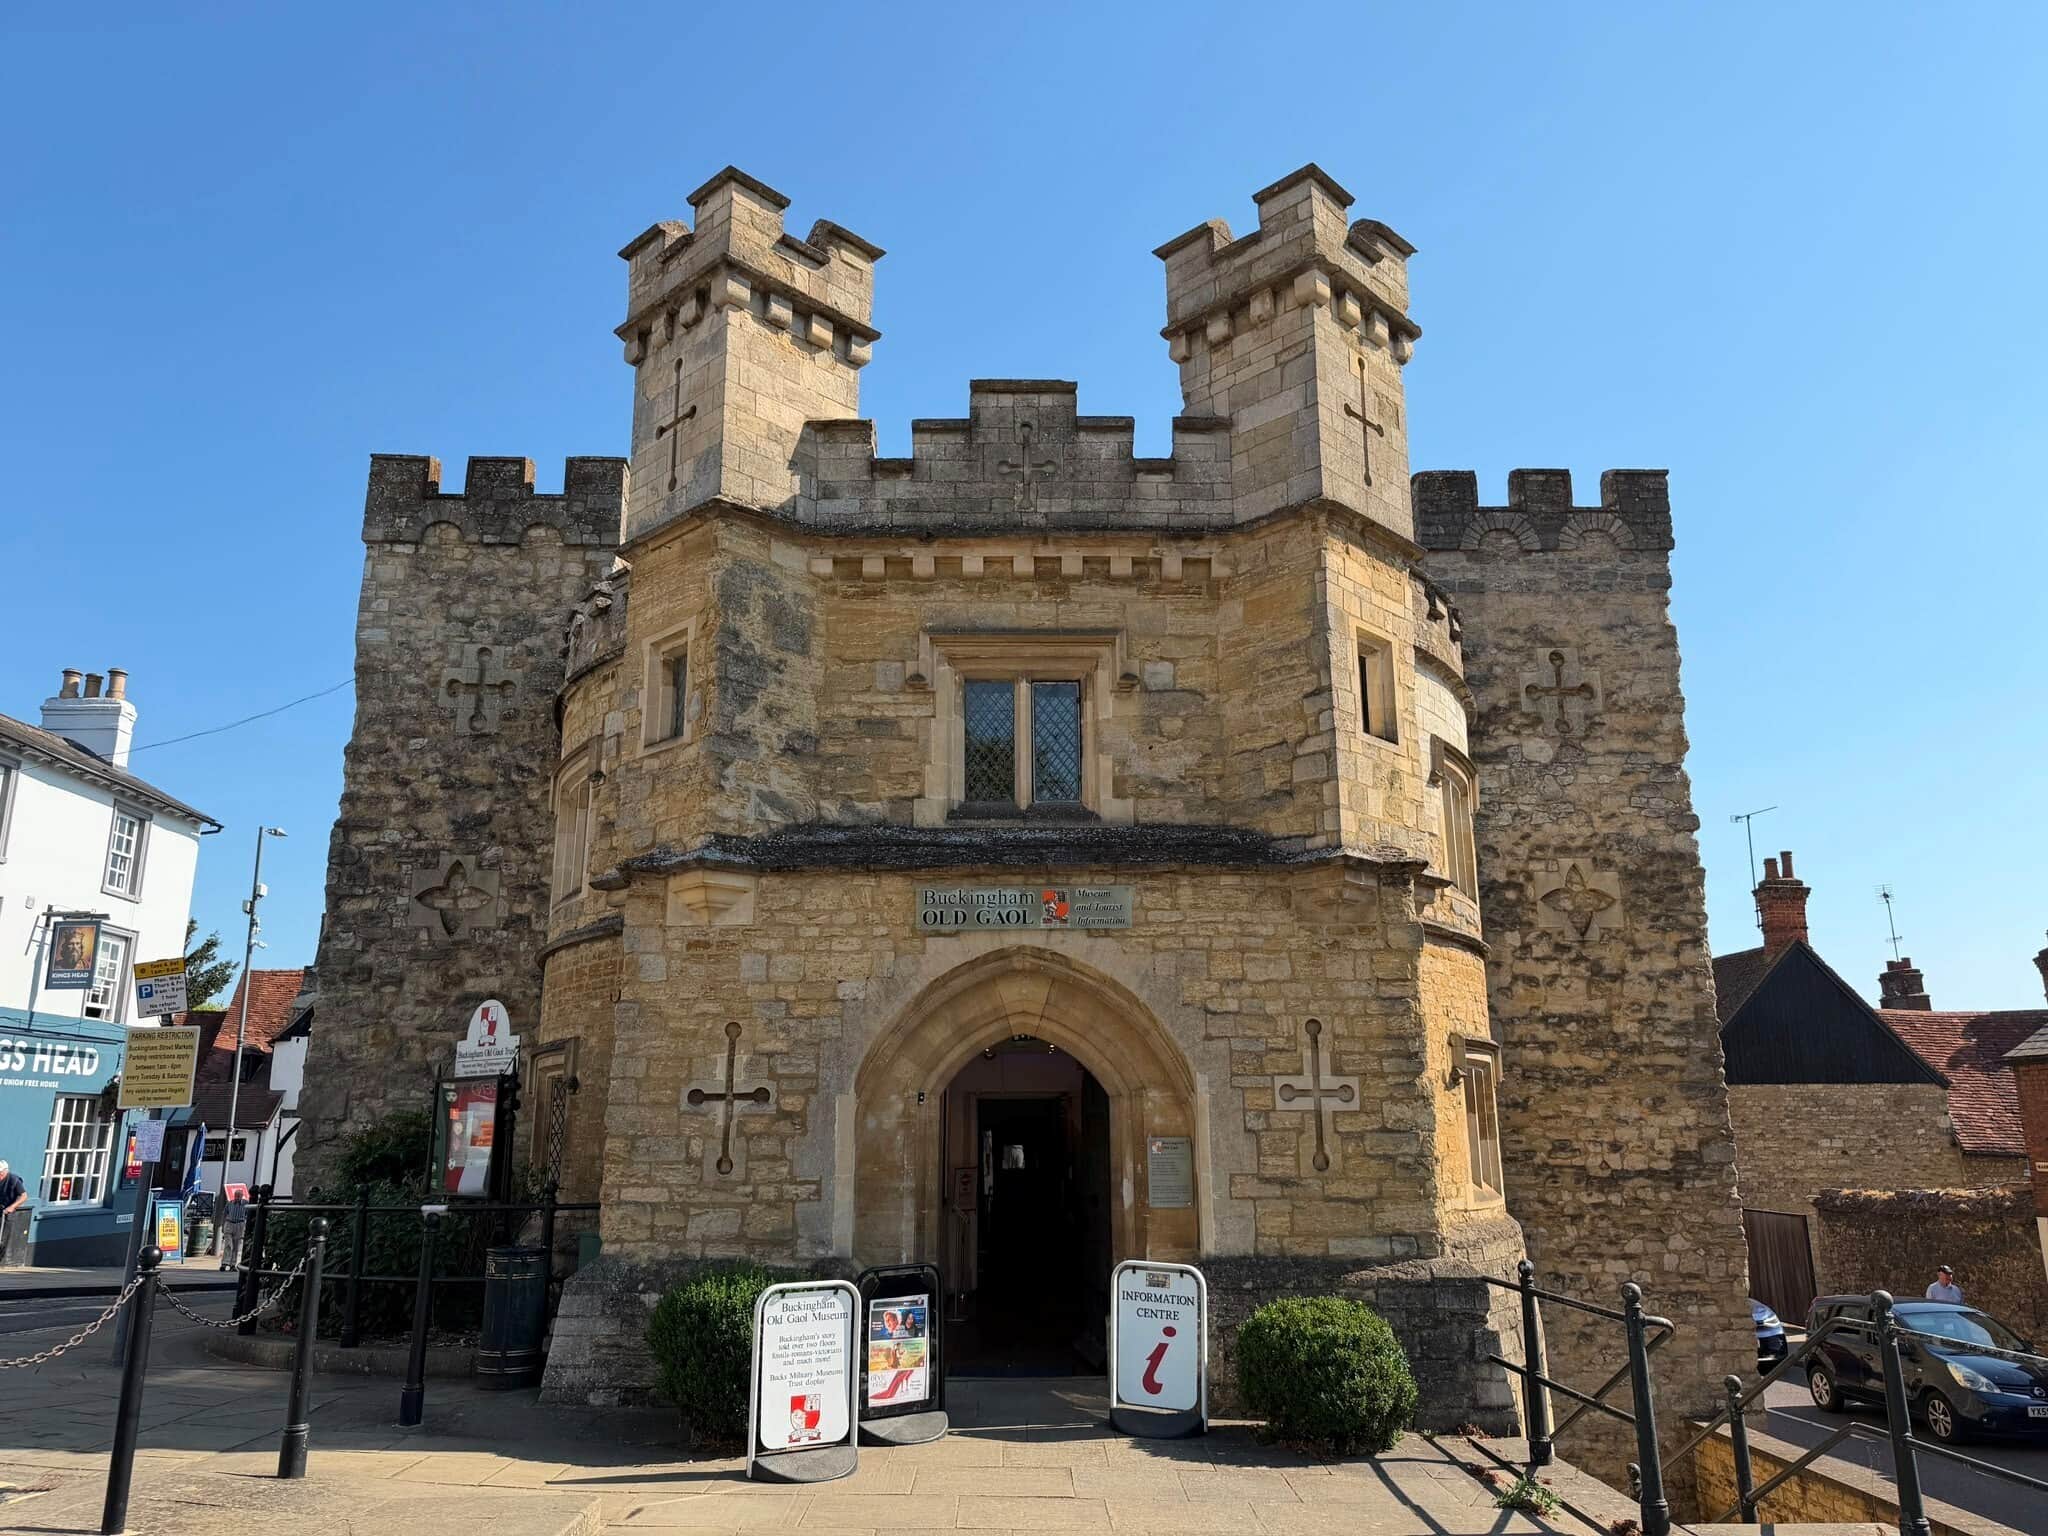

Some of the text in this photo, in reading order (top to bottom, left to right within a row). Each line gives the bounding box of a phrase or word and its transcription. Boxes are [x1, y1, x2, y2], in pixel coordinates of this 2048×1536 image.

[1075, 888, 1111, 897] Museum
[924, 889, 1034, 908] Buckingham
[1075, 902, 1123, 911] and Tourist
[922, 909, 1034, 925] OLD GAOL
[1077, 916, 1126, 926] Information
[131, 1031, 195, 1040] PARKING RESTRICTION
[32, 1043, 99, 1077] HEAD
[140, 1073, 161, 1081] Tuesday
[166, 1072, 189, 1081] Saturday
[39, 1080, 60, 1089] HOUSE
[1121, 1290, 1195, 1306] INFORMATION
[782, 1300, 835, 1313] Buckingham
[766, 1310, 848, 1325] Old Gaol Museum
[1136, 1307, 1180, 1321] CENTRE
[779, 1332, 836, 1343] Buckingham's story
[778, 1342, 790, 1350] told
[806, 1340, 818, 1348] two
[819, 1338, 837, 1347] floors
[782, 1358, 795, 1366] and
[796, 1356, 813, 1364] much
[769, 1373, 788, 1382] Bucks
[787, 1379, 803, 1388] Trust
